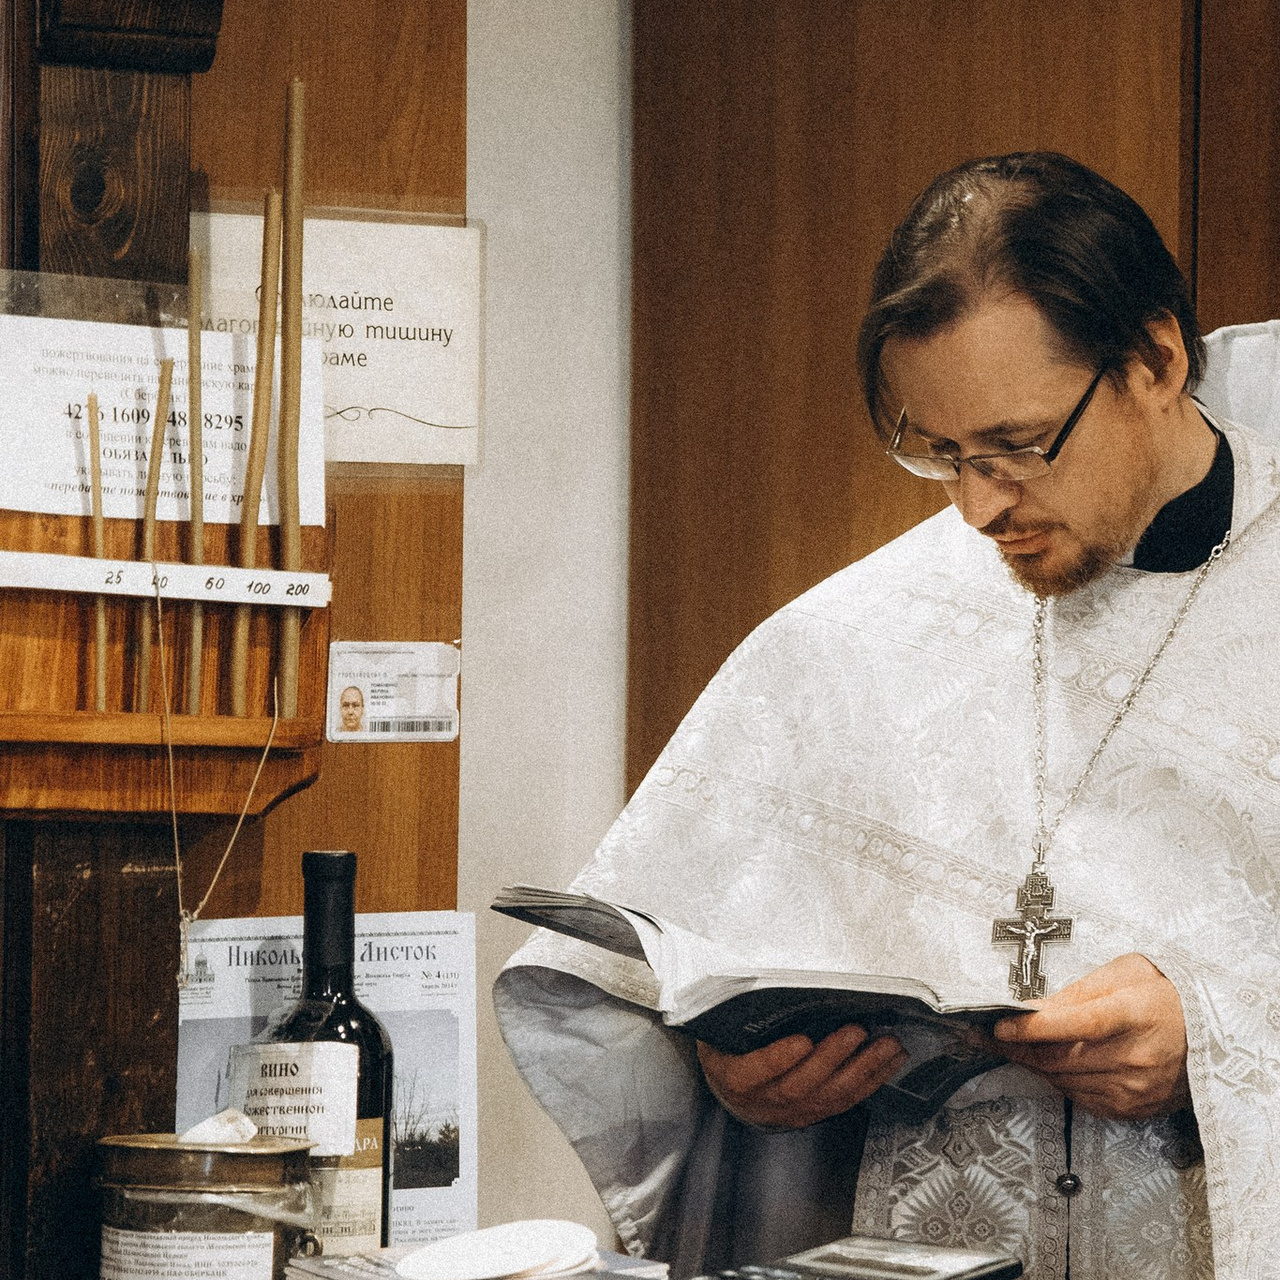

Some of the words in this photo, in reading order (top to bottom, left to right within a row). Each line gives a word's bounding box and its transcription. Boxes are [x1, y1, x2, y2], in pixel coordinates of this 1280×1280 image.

[365, 324, 454, 348] тишину
[63, 402, 104, 420] 426
[112, 406, 151, 424] 1609
[204, 413, 244, 433] 8295
[105, 569, 124, 586] 25
[204, 575, 226, 591] 60
[246, 580, 272, 596] 100
[285, 582, 311, 597] 200
[261, 1062, 300, 1078] ВИНО
